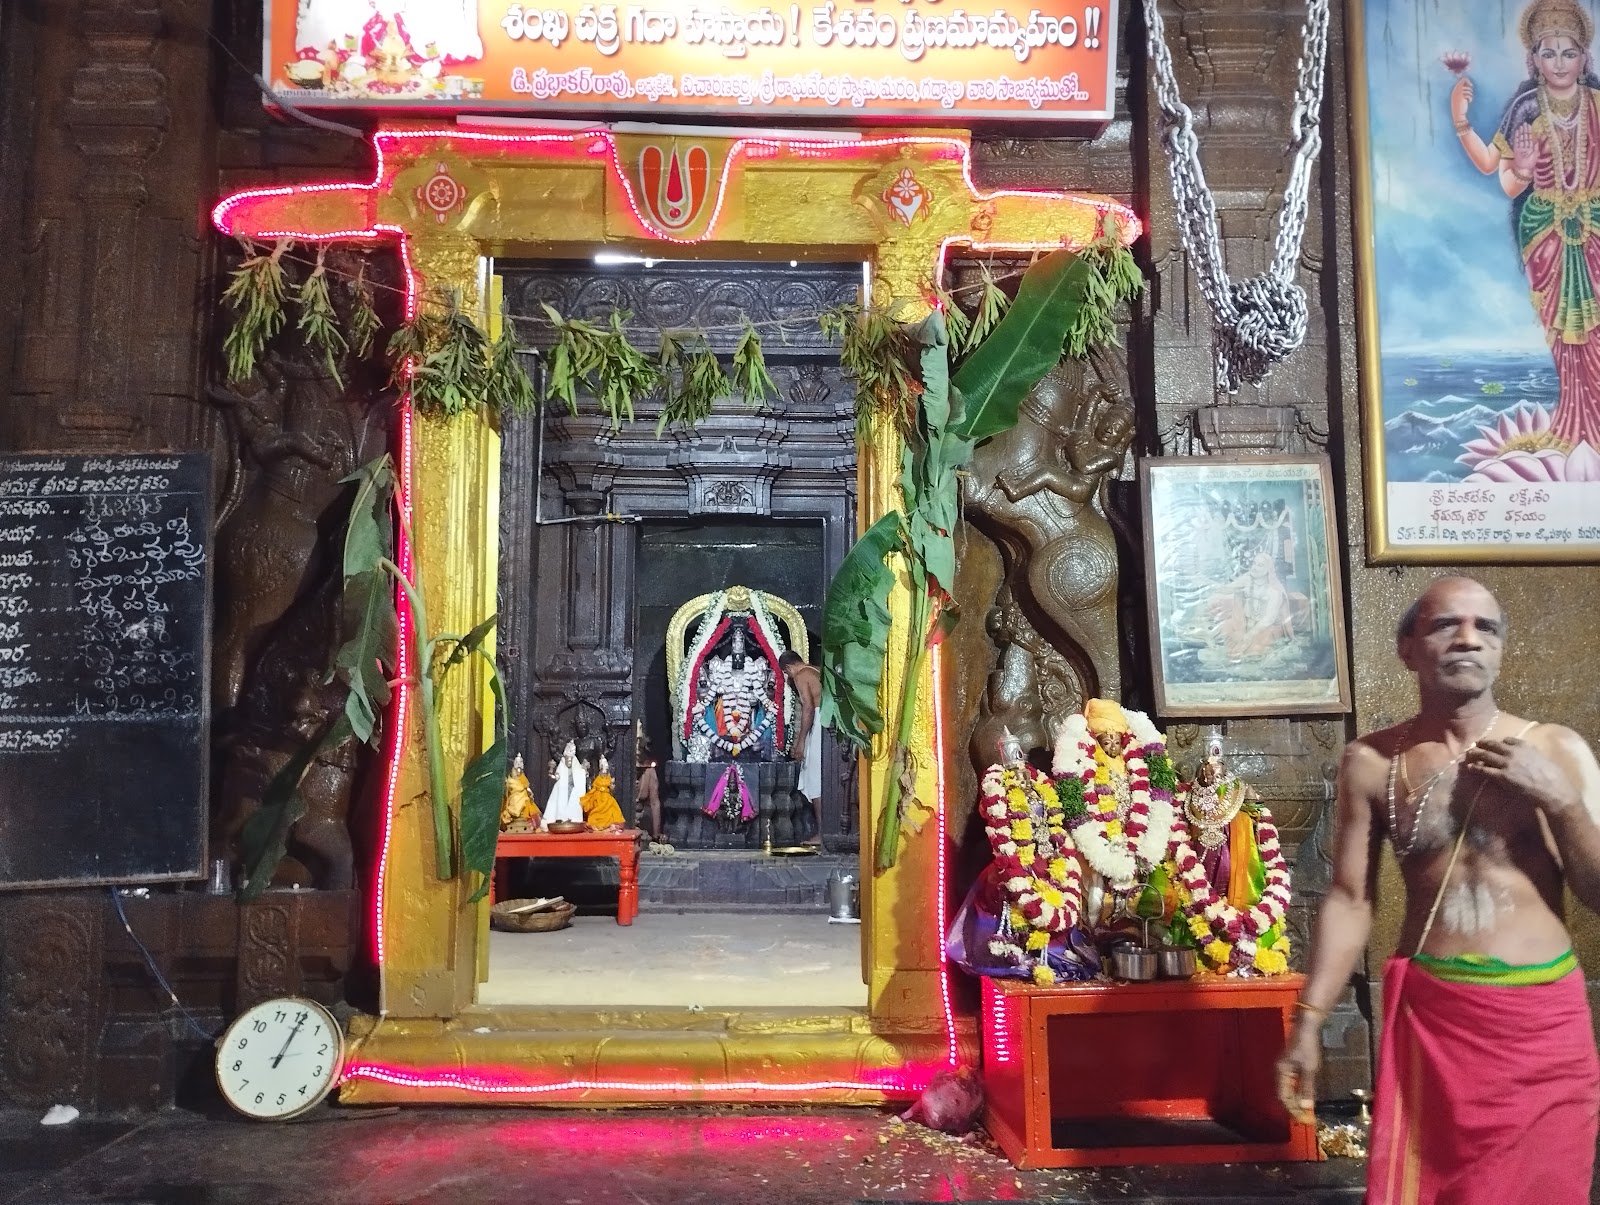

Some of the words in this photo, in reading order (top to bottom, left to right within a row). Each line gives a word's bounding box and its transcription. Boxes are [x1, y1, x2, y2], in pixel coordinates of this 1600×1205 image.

[500, 4, 568, 47] శంఖ
[575, 3, 620, 55] చక్ర
[625, 5, 677, 43] గదా
[812, 1, 896, 47] కేశవం
[899, 8, 1077, 62] ప్రణమామ్యహం
[274, 1011, 287, 1024] 11
[294, 1011, 308, 1025] 12
[252, 1019, 267, 1033] 10
[314, 1025, 321, 1036] 1
[238, 1038, 248, 1049] 9
[317, 1043, 328, 1055] 2
[232, 1060, 242, 1072] 8
[312, 1065, 323, 1077] 3
[238, 1079, 249, 1091] 7
[298, 1084, 308, 1096] 4
[254, 1092, 265, 1104] 6
[276, 1093, 287, 1106] 5
